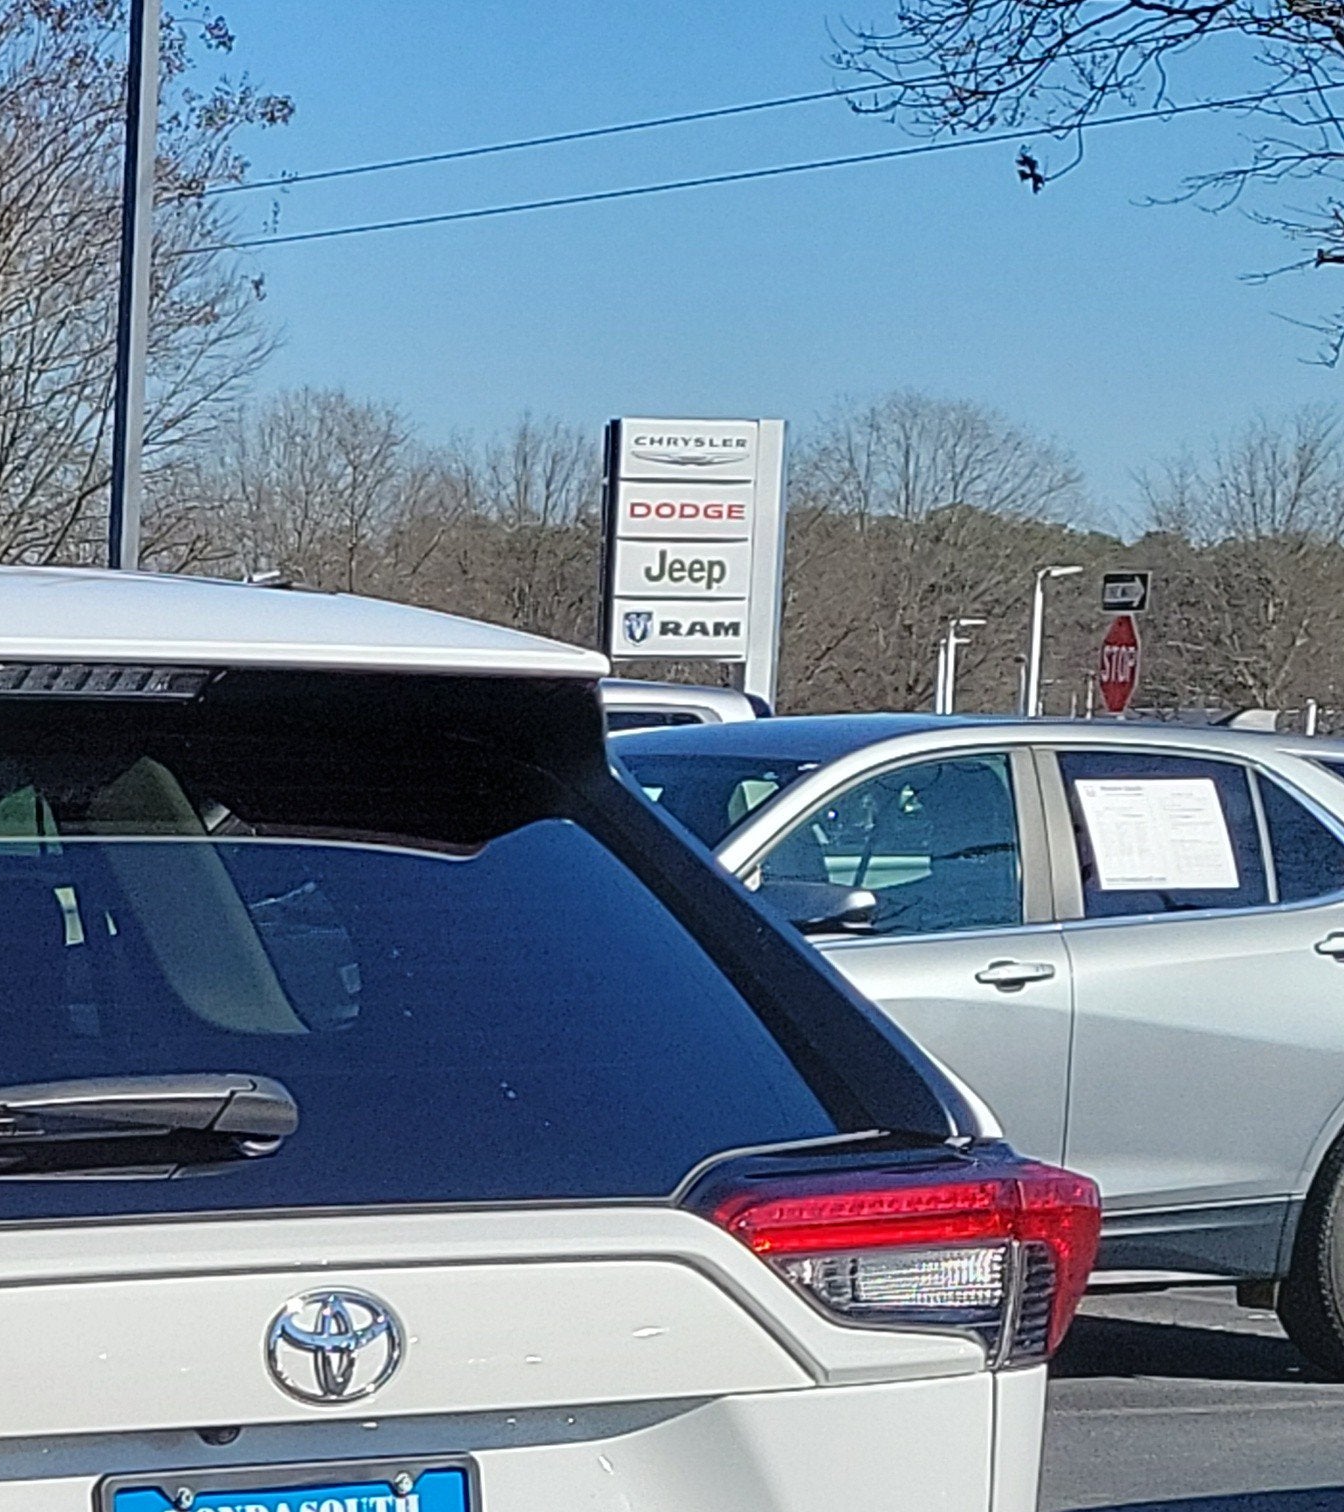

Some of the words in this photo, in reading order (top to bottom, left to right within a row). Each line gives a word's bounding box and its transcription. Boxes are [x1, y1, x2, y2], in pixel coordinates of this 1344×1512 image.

[633, 436, 748, 448] CHRYSLER
[629, 502, 746, 520] DODGE
[643, 549, 727, 590] Jeep
[658, 621, 741, 637] RAM
[1101, 645, 1136, 682] STOP
